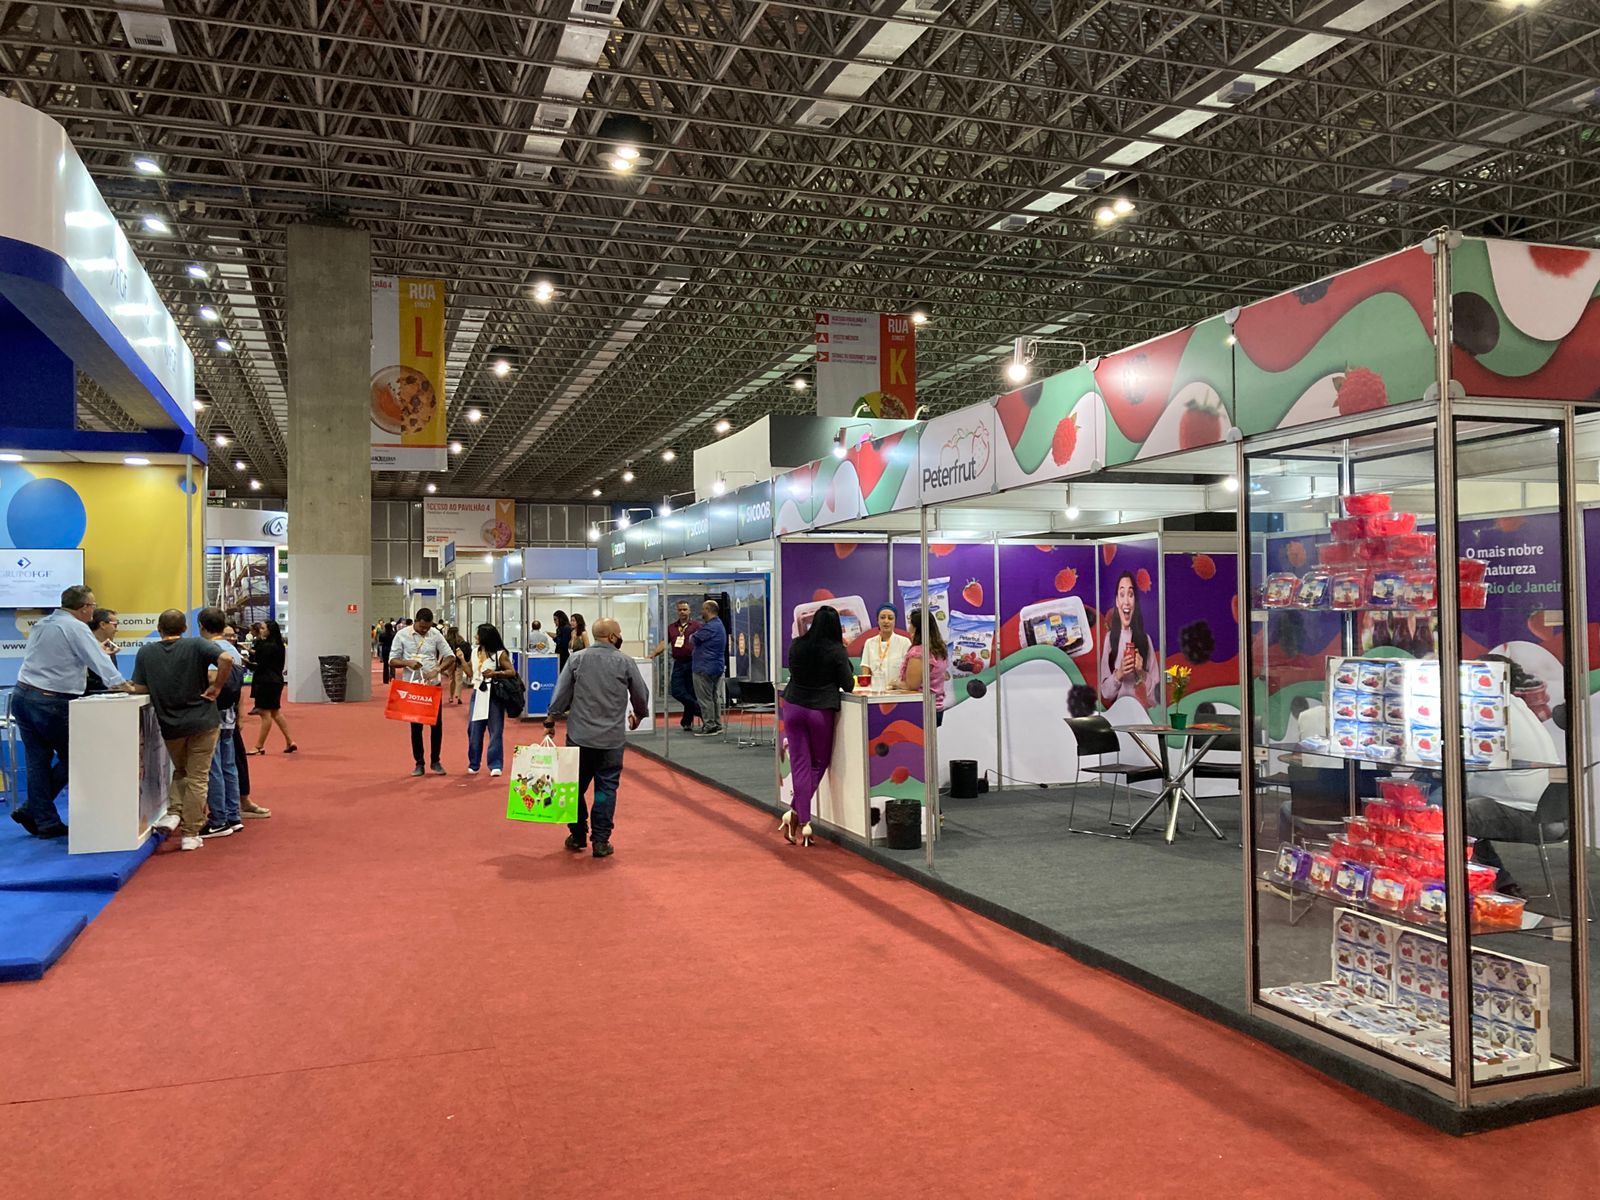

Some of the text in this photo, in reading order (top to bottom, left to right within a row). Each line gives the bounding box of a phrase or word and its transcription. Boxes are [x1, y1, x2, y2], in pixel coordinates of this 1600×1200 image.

[409, 283, 436, 300] RUA
[888, 318, 909, 334] RUA
[415, 316, 433, 357] L
[890, 348, 907, 385] K
[923, 457, 976, 493] Peterfrut
[1466, 543, 1544, 558] O mais nobre
[1484, 564, 1537, 576] natureza
[1507, 581, 1522, 593] de
[1524, 580, 1561, 593] Janeir
